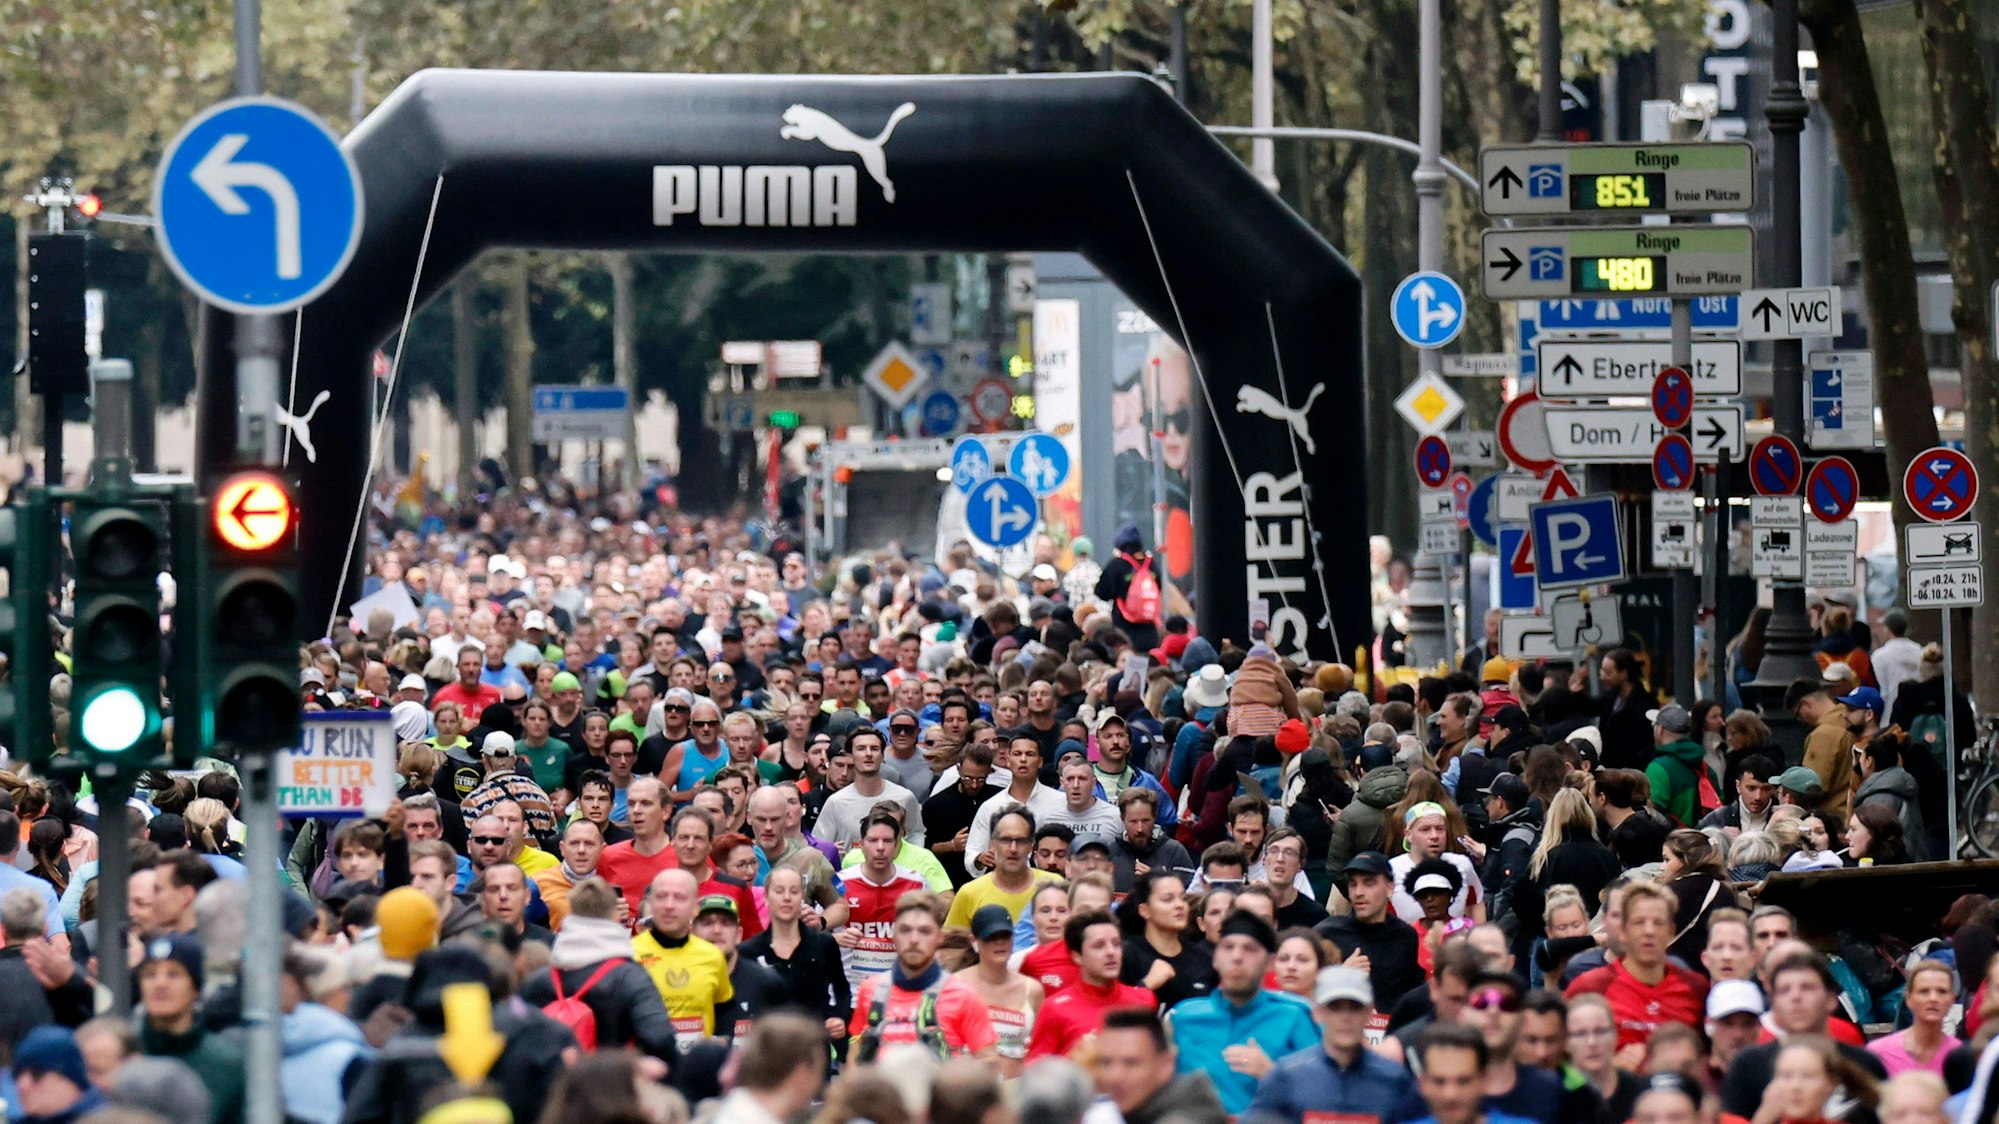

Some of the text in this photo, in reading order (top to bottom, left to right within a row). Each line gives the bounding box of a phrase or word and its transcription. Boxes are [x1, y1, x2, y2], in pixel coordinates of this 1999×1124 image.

[1635, 151, 1679, 169] Ringe
[653, 165, 857, 226] PUMA
[1596, 175, 1650, 207] 851
[1675, 189, 1701, 201] freie
[1636, 233, 1681, 252] Ringe
[1598, 257, 1653, 291] 480
[1676, 272, 1701, 284] freie
[1790, 302, 1829, 323] WC
[1593, 357, 1717, 379] Eberttz
[1570, 422, 1622, 445] Dom
[1546, 512, 1591, 574] P
[1808, 532, 1853, 543] Ladezone
[1245, 471, 1310, 666] STER
[1961, 573, 1977, 584] 21h
[323, 727, 375, 758] RUN
[293, 760, 374, 786] BETTER
[278, 787, 363, 806] THAN DB
[1091, 823, 1102, 832] IT
[850, 920, 897, 939] REW
